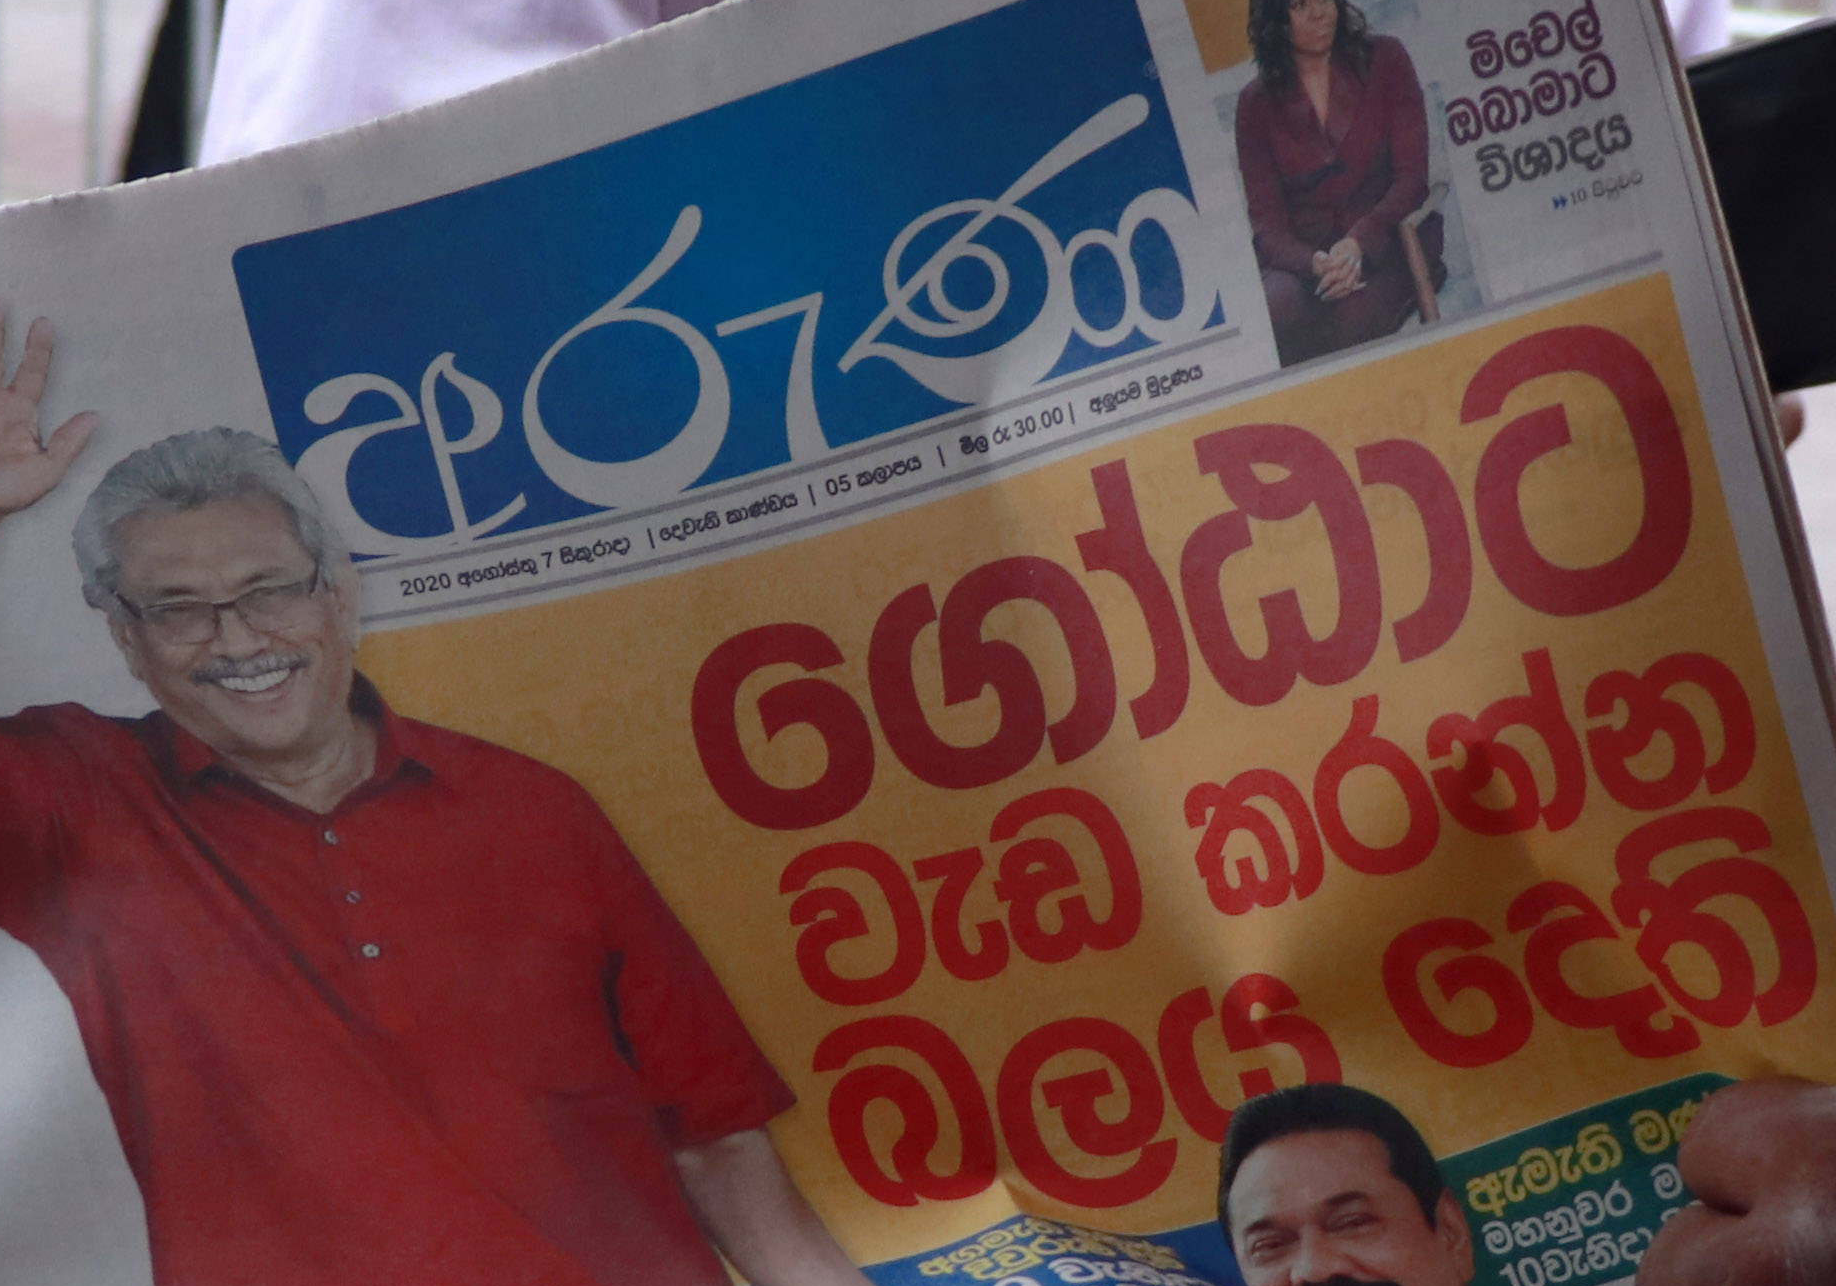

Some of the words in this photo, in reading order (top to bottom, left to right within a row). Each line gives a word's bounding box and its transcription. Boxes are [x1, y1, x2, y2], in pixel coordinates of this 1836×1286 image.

[1445, 51, 1617, 146] ඔබාමාට
[1014, 407, 1063, 437] 30.00
[825, 474, 851, 496] 05
[400, 573, 451, 596] 2020
[542, 551, 553, 570] 7
[690, 322, 1693, 832] ගෝඨාට
[779, 786, 1144, 1009] වැඩ
[1184, 648, 1759, 916] කරන්න
[812, 970, 1343, 1209] බලය
[1463, 1121, 1622, 1217] ඇමැති
[1480, 1178, 1634, 1255] මහනුවර
